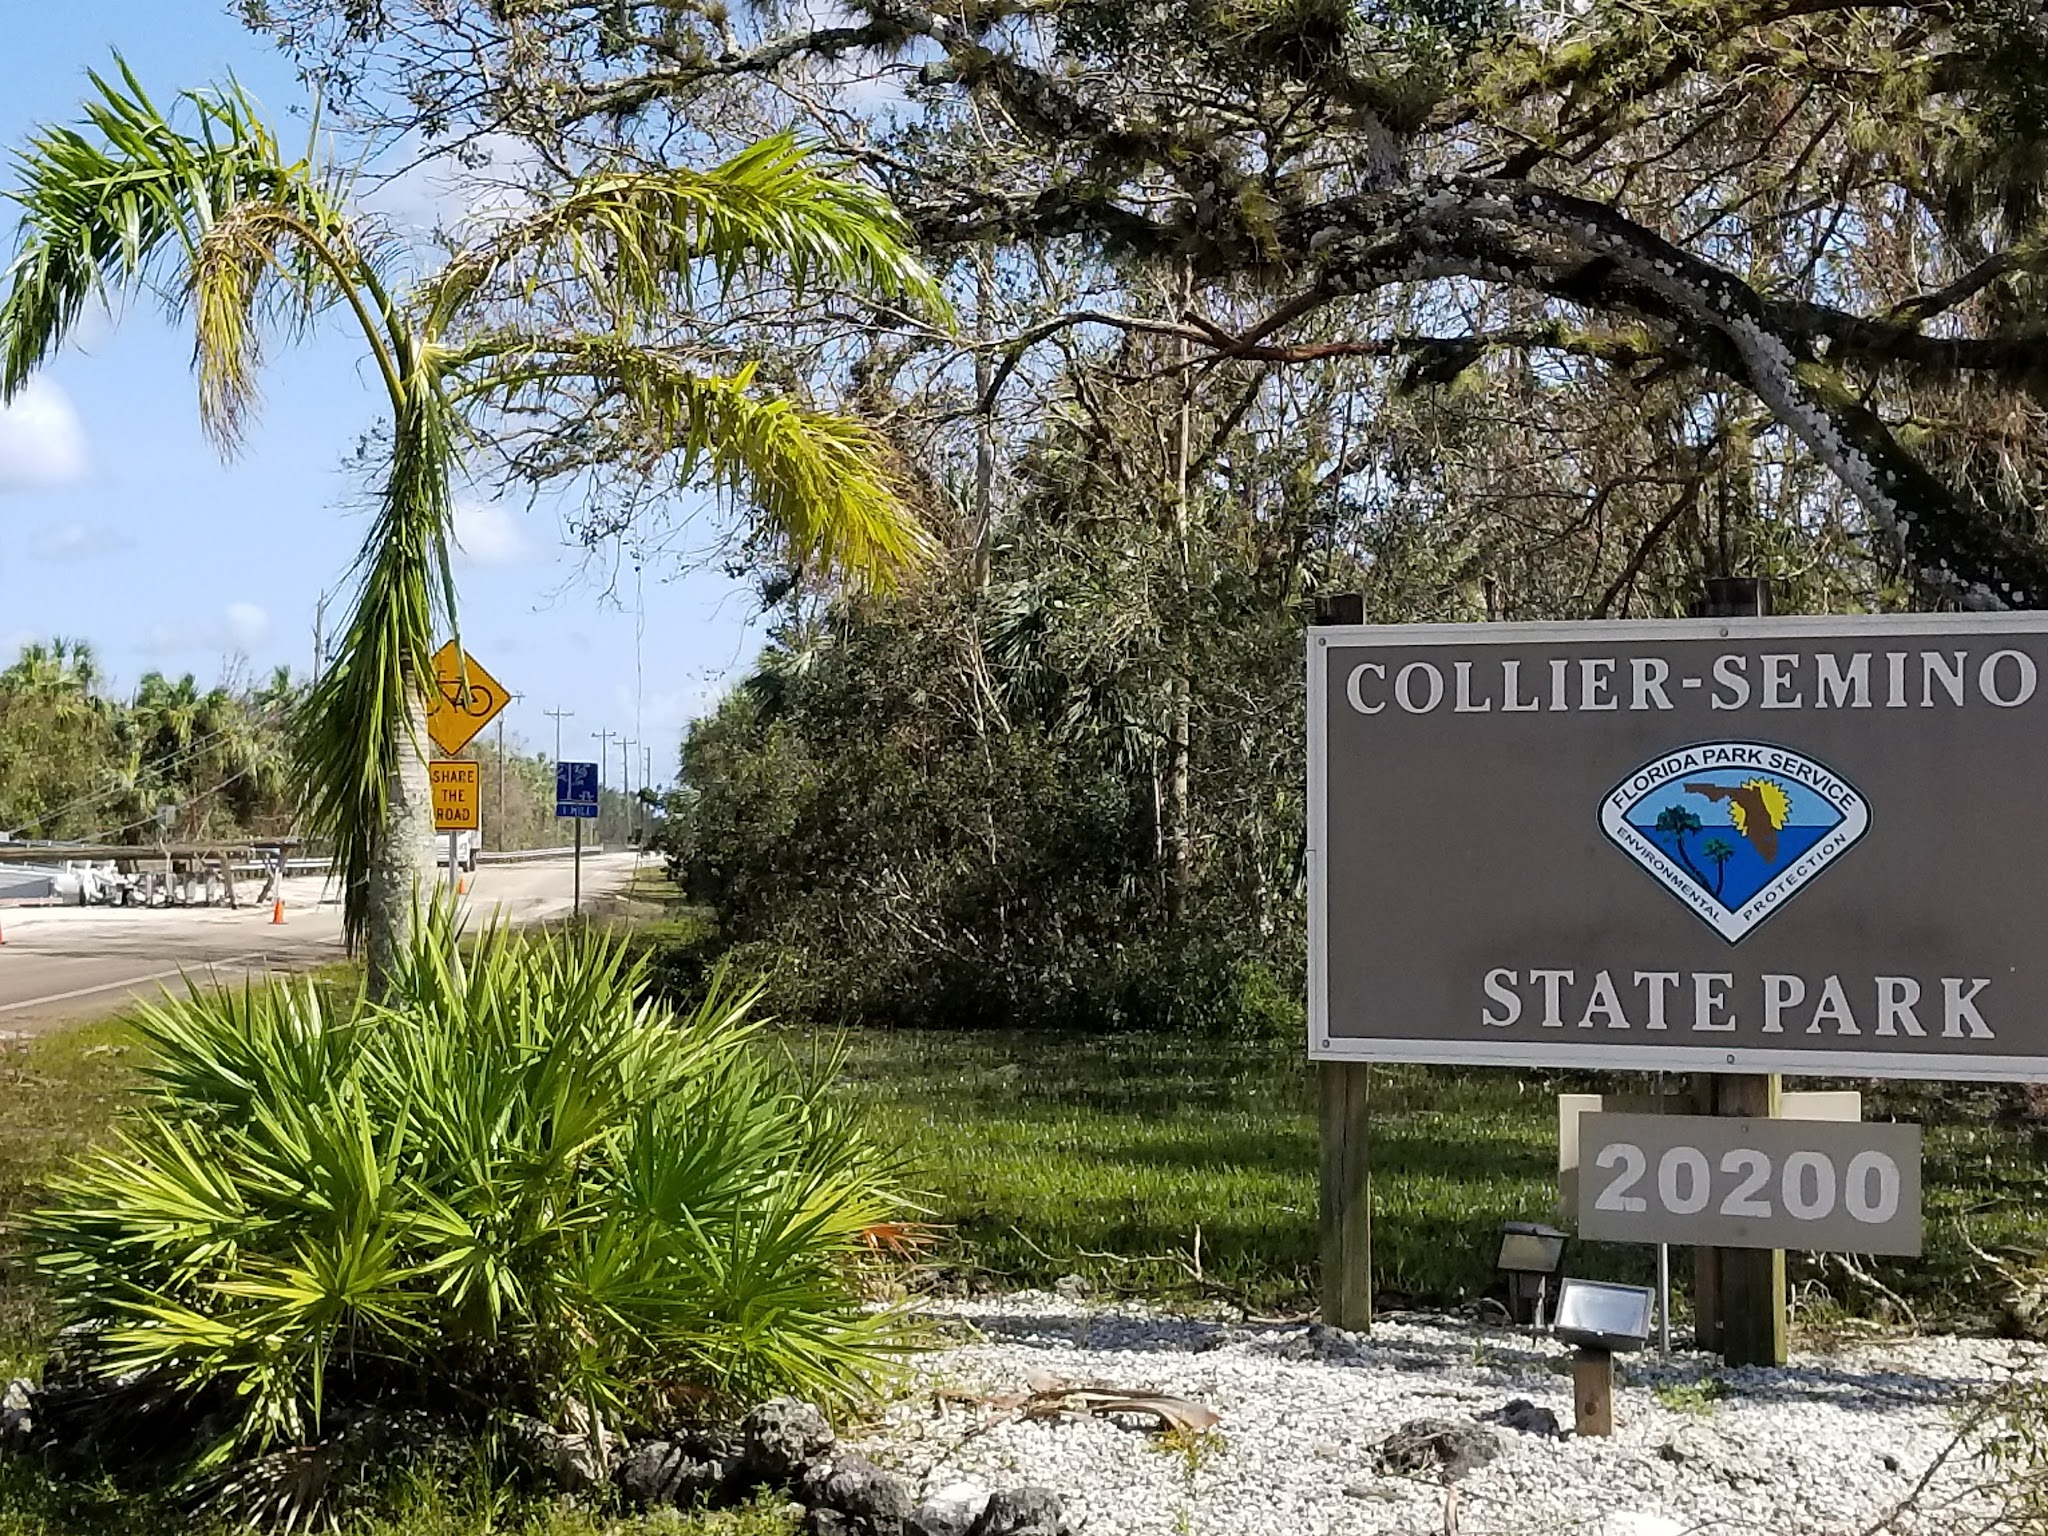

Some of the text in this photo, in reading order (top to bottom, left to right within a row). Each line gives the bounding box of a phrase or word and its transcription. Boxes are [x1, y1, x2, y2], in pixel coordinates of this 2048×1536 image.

[432, 770, 475, 783] SHARE
[441, 789, 466, 802] THE
[1611, 748, 1857, 812] FLORIDA PARK SERVICE
[436, 808, 471, 821] ROAD
[1616, 826, 1721, 924] ENVIRONMENTAL
[1743, 832, 1847, 922] PROTECTION
[1482, 968, 1996, 1040] STATE PARK
[1594, 1143, 1901, 1224] 20200
